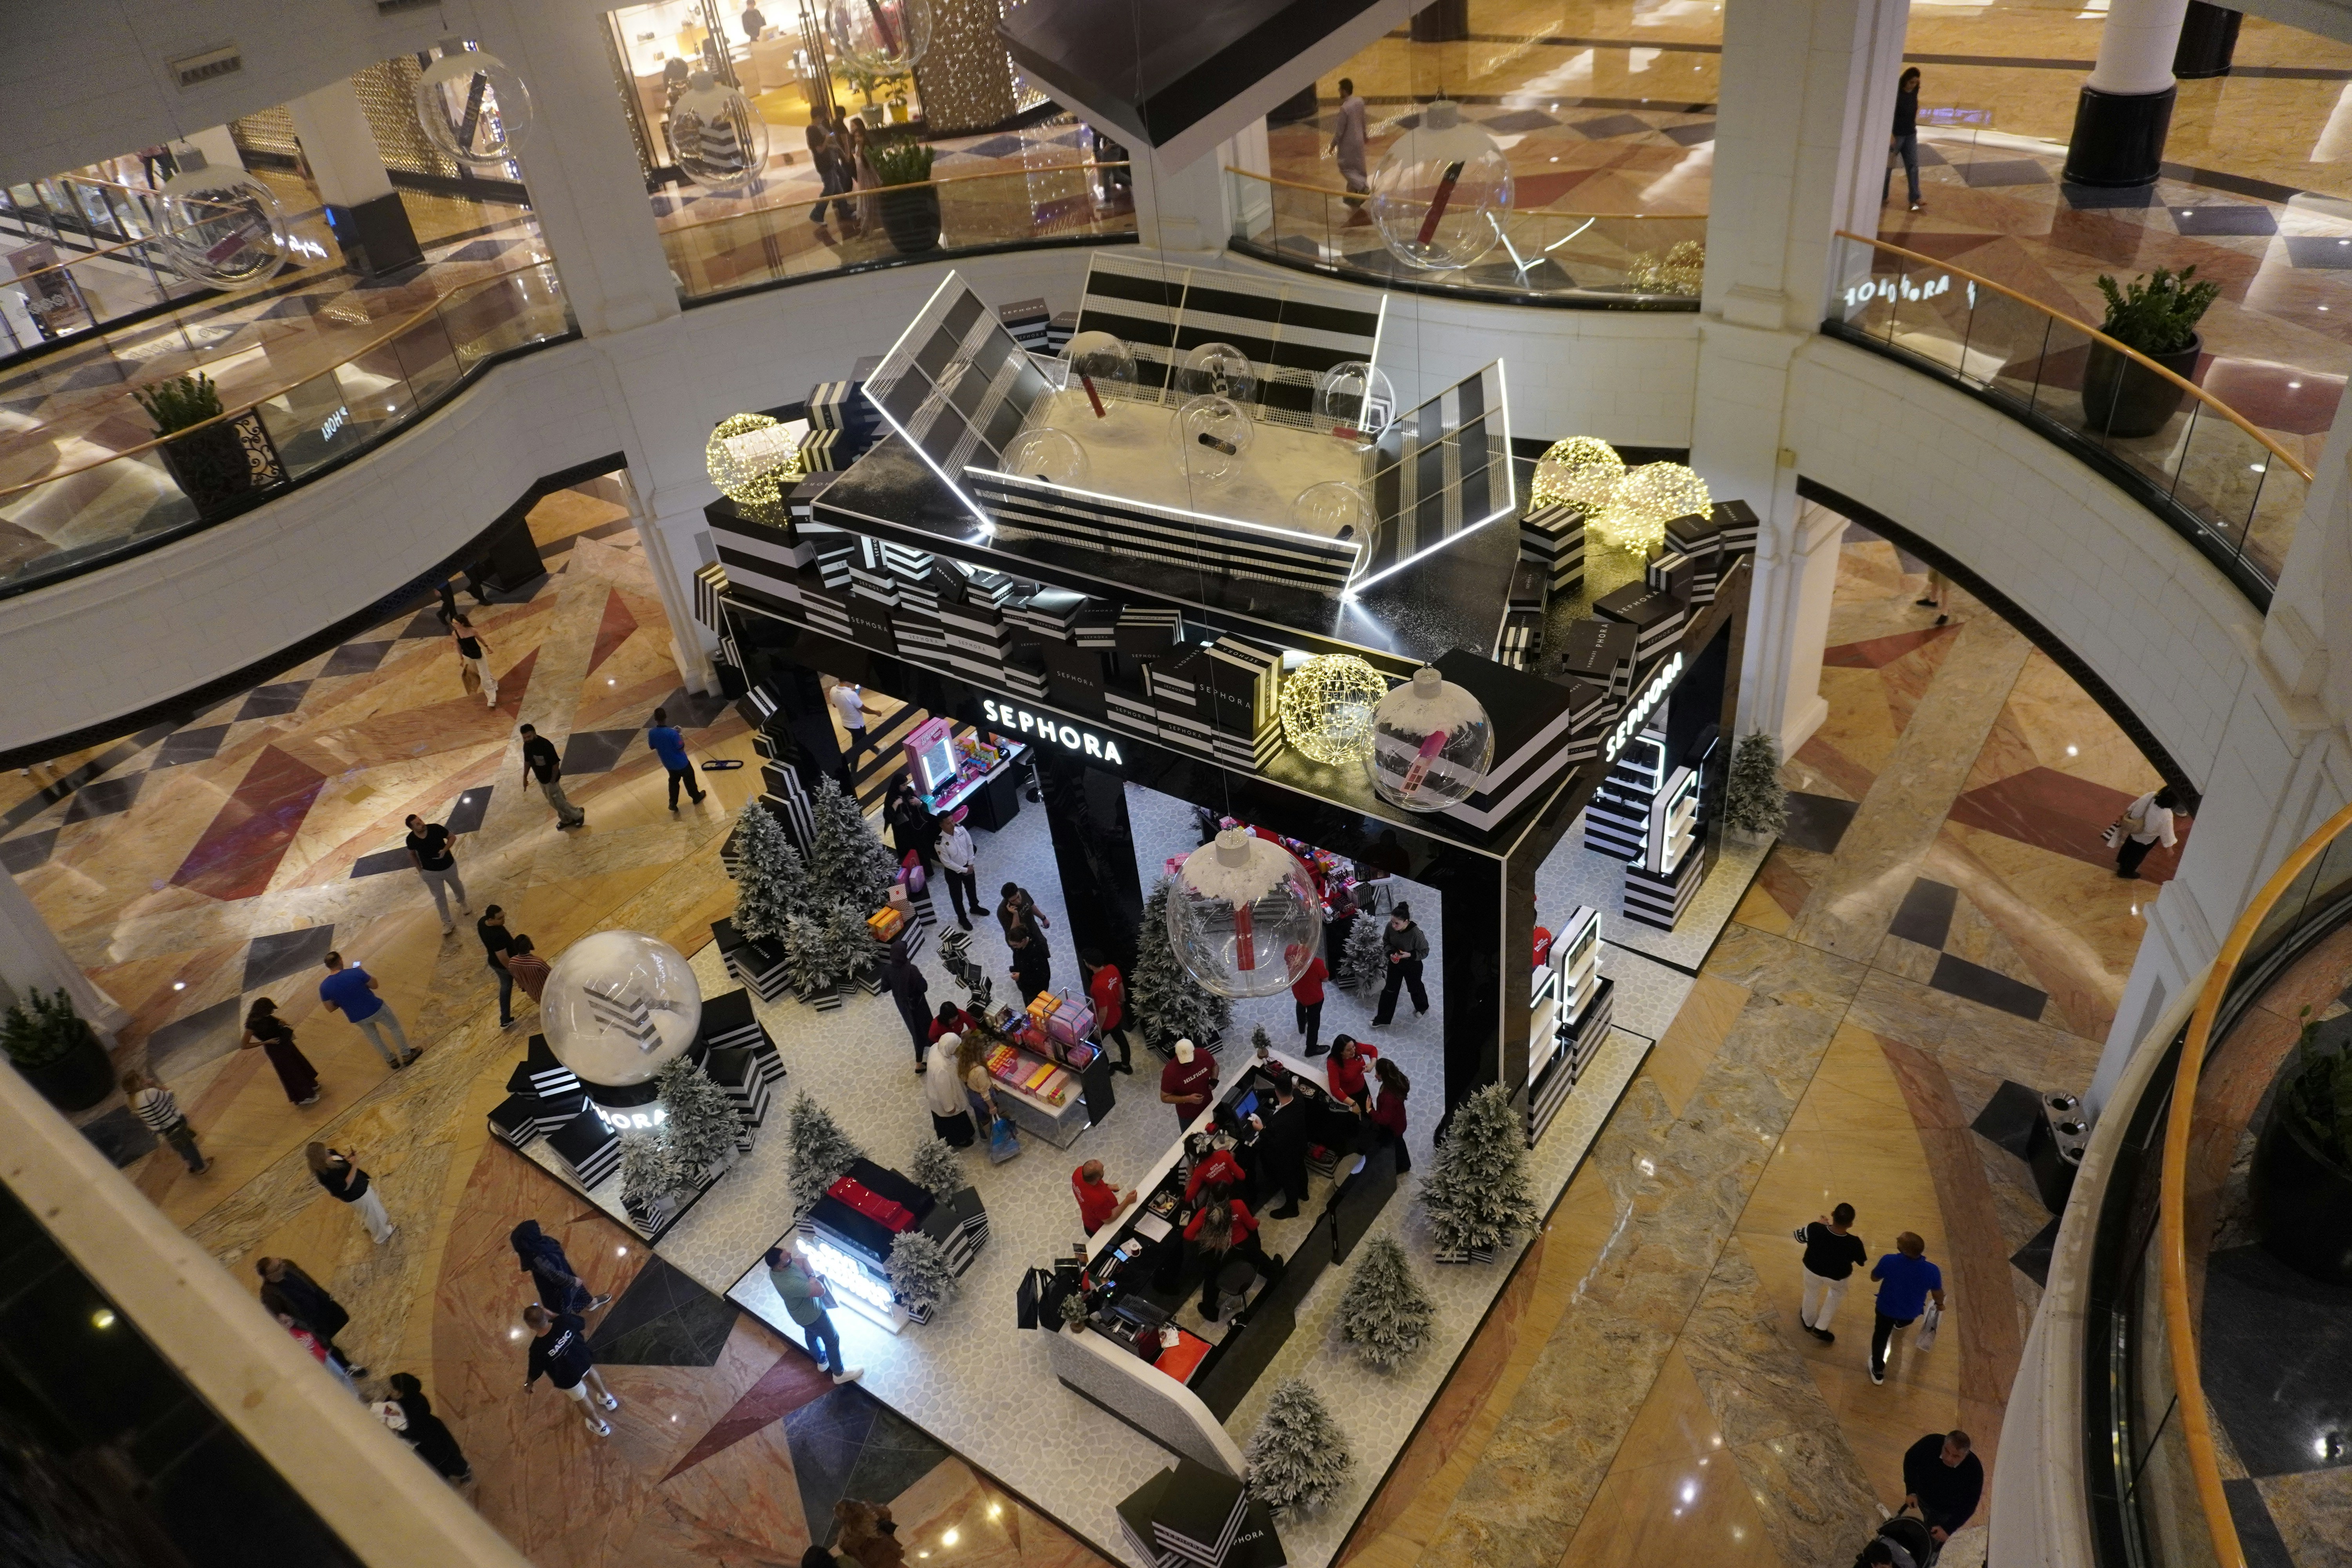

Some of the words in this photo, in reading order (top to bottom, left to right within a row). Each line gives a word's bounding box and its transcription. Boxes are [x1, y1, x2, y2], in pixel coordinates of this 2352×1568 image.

[1003, 305, 1044, 315] SEPHORA
[1722, 504, 1737, 521] SEPHORA
[936, 566, 957, 587] SEPHORA
[858, 580, 884, 593] SEPHORA
[1617, 590, 1660, 614] SEPHORA
[851, 616, 889, 632] SEPHORA
[908, 634, 938, 644] SEPHORA
[1596, 624, 1609, 648] PHORA
[1648, 627, 1675, 645] SEPHORA
[958, 639, 986, 652] SEPHORA
[1173, 649, 1200, 669] SEPHORA
[1223, 647, 1258, 664] SEPHORA
[1587, 650, 1597, 668] SEPHORA
[1013, 677, 1032, 686] SEPHORA
[1057, 670, 1094, 687] SEPHORA
[1163, 684, 1185, 694] SEPHORA
[1200, 683, 1251, 710] SEPHORA
[1116, 706, 1147, 720] SEPHORA
[1606, 652, 1682, 762] SEPHORA
[983, 699, 1123, 765] SEPHORA
[1169, 724, 1202, 739] SEPHORA
[752, 944, 770, 960] SEPHORA
[1183, 1067, 1208, 1084] HILFIGER
[589, 1098, 670, 1129] HORA
[548, 1330, 572, 1357] BASIC
